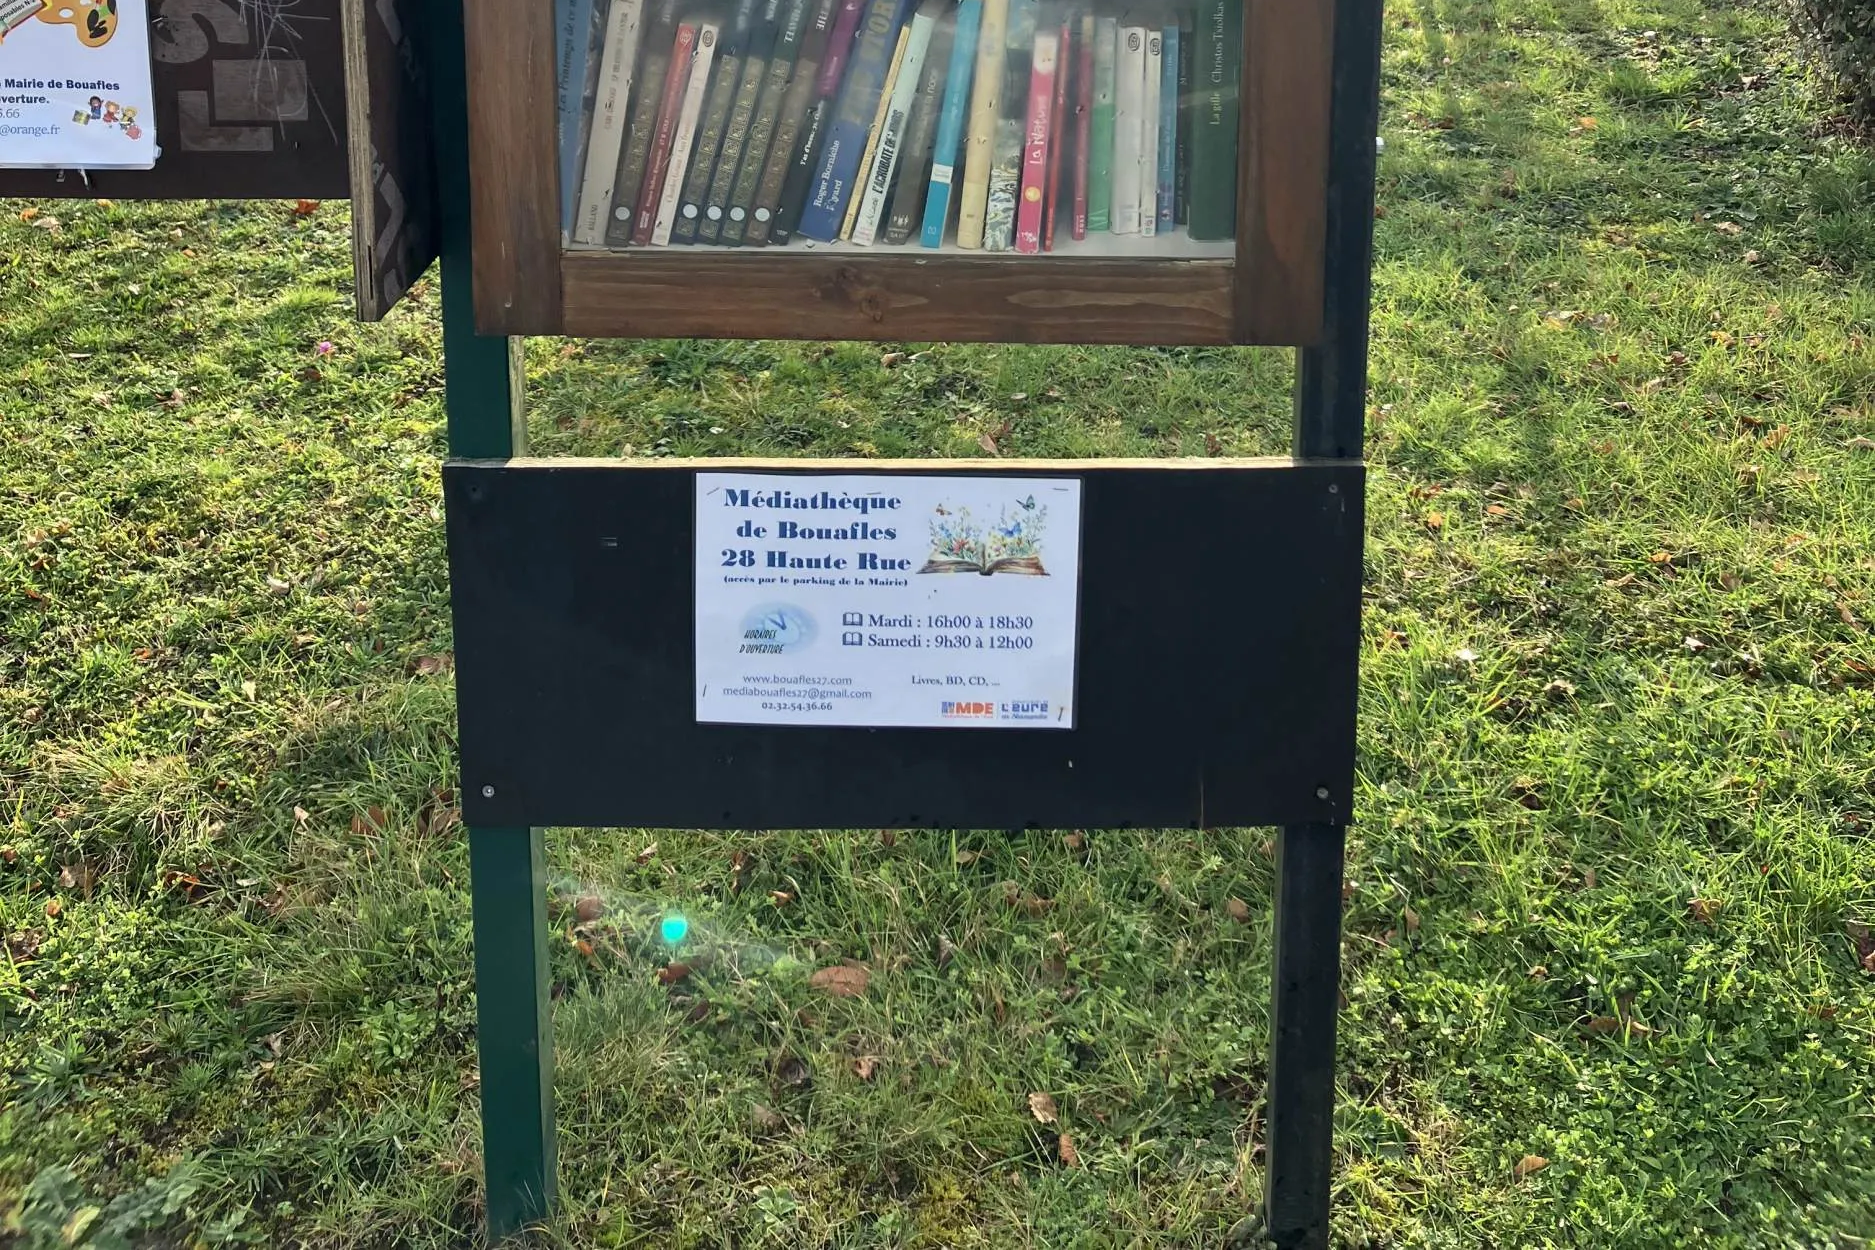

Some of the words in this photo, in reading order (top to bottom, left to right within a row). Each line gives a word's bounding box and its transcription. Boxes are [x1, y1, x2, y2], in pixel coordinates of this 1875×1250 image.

[1210, 43, 1224, 83] Christos
[4, 78, 45, 89] Mairie
[47, 79, 63, 89] de
[66, 79, 120, 91] Bouafles
[0, 93, 50, 104] verture.
[1029, 150, 1042, 165] La
[813, 176, 829, 208] Roger
[822, 139, 840, 176] Borniche
[870, 142, 895, 195] L'ACROBATE
[724, 488, 902, 515] Médiathèque
[736, 519, 768, 539] de
[777, 520, 898, 541] Bouafles
[720, 548, 756, 568] 28
[766, 550, 848, 570] Haute
[856, 552, 912, 571] Rue
[758, 577, 777, 586] par
[780, 575, 791, 584] le
[793, 575, 836, 587] parking
[838, 576, 851, 586] de
[854, 577, 865, 586] la
[868, 578, 908, 588] Mairie)
[867, 613, 913, 629] Mardi
[927, 615, 971, 630] 16h00
[975, 616, 984, 629] à
[989, 616, 1033, 630] 18h30
[867, 633, 922, 649] Samedi
[935, 635, 971, 650] 9h30
[975, 635, 984, 650] à
[989, 636, 1033, 650] 12h00
[742, 673, 853, 686] www.bouafles27.com
[911, 675, 944, 687] Livres,
[946, 676, 967, 687] BD,
[968, 676, 989, 687] CD,
[722, 686, 873, 700] mediabouafles27@gmail.com
[761, 701, 834, 712] 02.32.54.36.66
[955, 702, 995, 715] MDE
